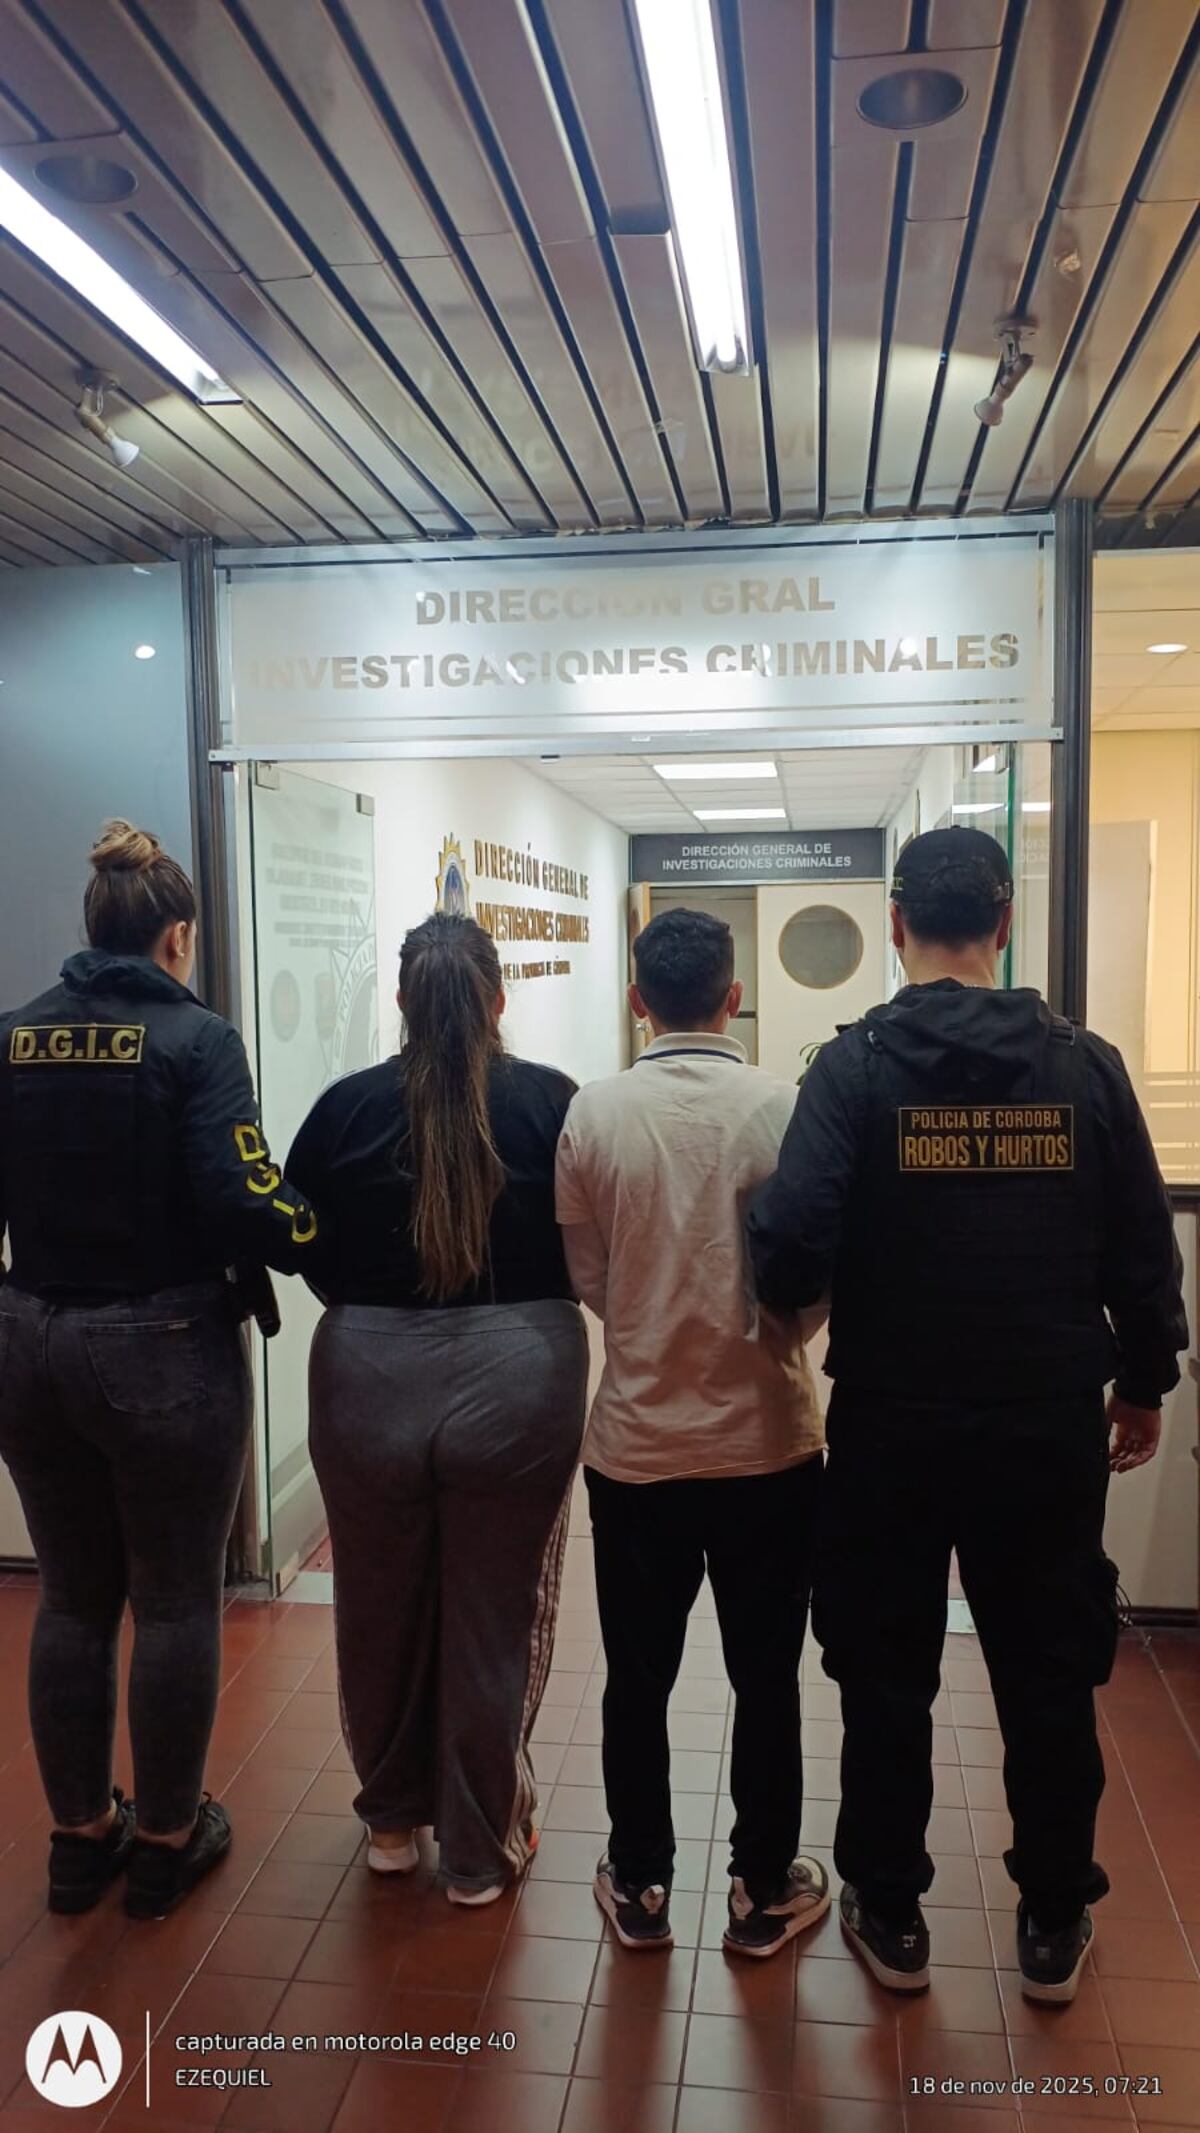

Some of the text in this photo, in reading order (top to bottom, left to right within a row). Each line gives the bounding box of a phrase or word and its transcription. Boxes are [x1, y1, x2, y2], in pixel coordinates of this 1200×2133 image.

[701, 576, 836, 615] GRAL
[253, 632, 1019, 690] INVESTIGACIONES CRIMINALES
[662, 856, 852, 870] INVESTIGACIONES CRIMINALES
[682, 842, 832, 857] DIRECCIÓN GENERAL DE
[475, 839, 540, 889] DIRECCIÓN
[542, 860, 579, 898] GENERAL
[911, 1110, 1062, 1129] POLICIA DE CORDOBA
[905, 1134, 1069, 1166] ROBOS Y HURTOS
